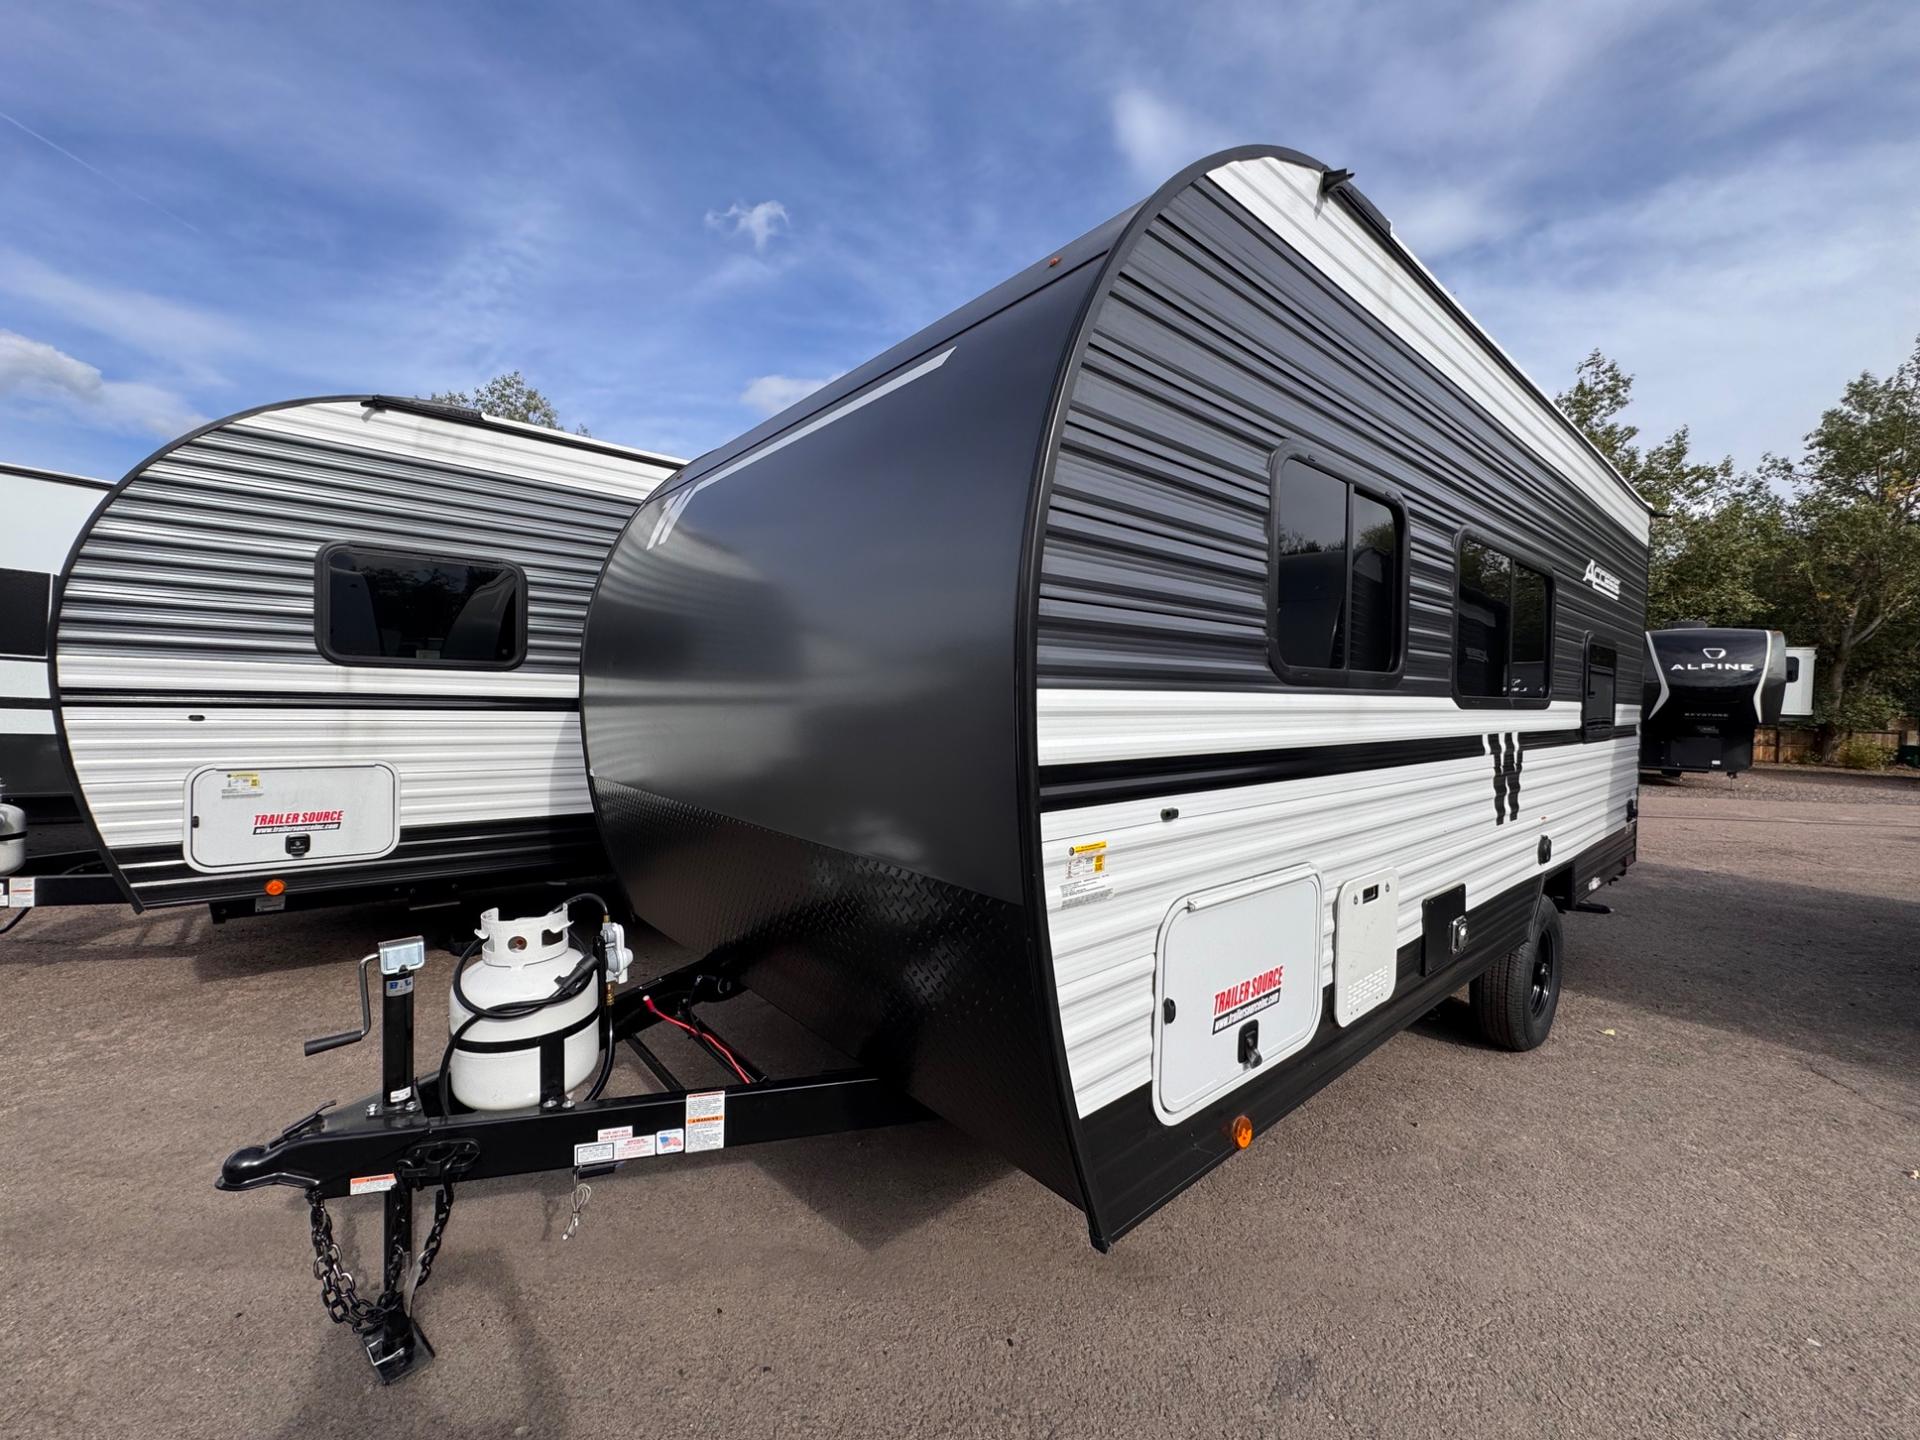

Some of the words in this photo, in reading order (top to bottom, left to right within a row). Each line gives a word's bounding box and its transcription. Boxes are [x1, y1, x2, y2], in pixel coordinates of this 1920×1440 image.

[1671, 663, 1754, 671] ALPINE
[254, 812, 300, 826] TRAILER
[301, 810, 344, 823] SOURCE
[1214, 979, 1251, 1016] TRAILER
[1251, 965, 1284, 998] SOURCE
